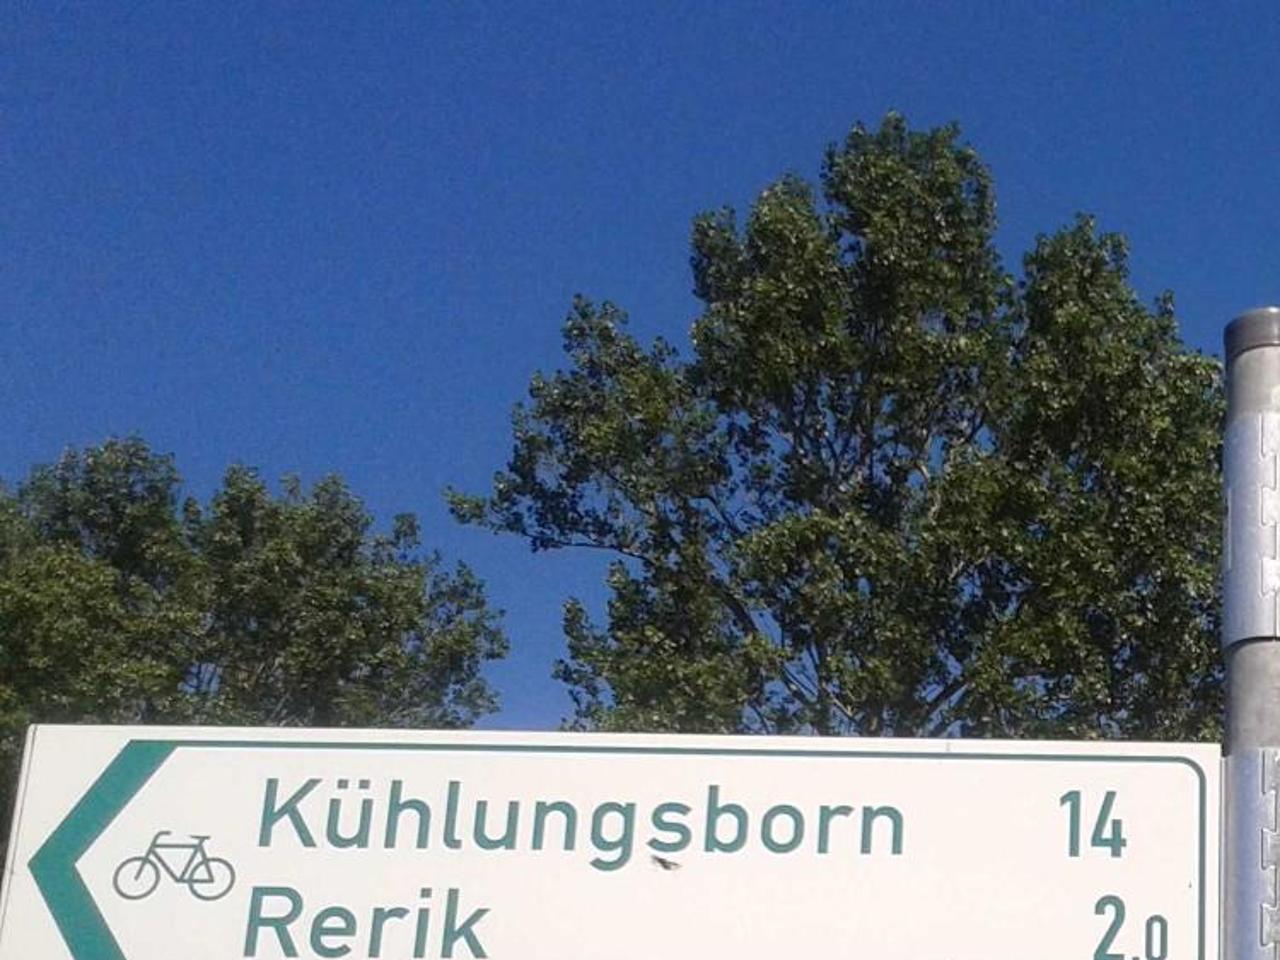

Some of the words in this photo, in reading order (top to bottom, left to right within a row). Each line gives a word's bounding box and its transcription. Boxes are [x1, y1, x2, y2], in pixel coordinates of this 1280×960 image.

[258, 778, 903, 872] Kühlungsborn
[1060, 790, 1127, 858] 14
[243, 886, 489, 959] Rerik
